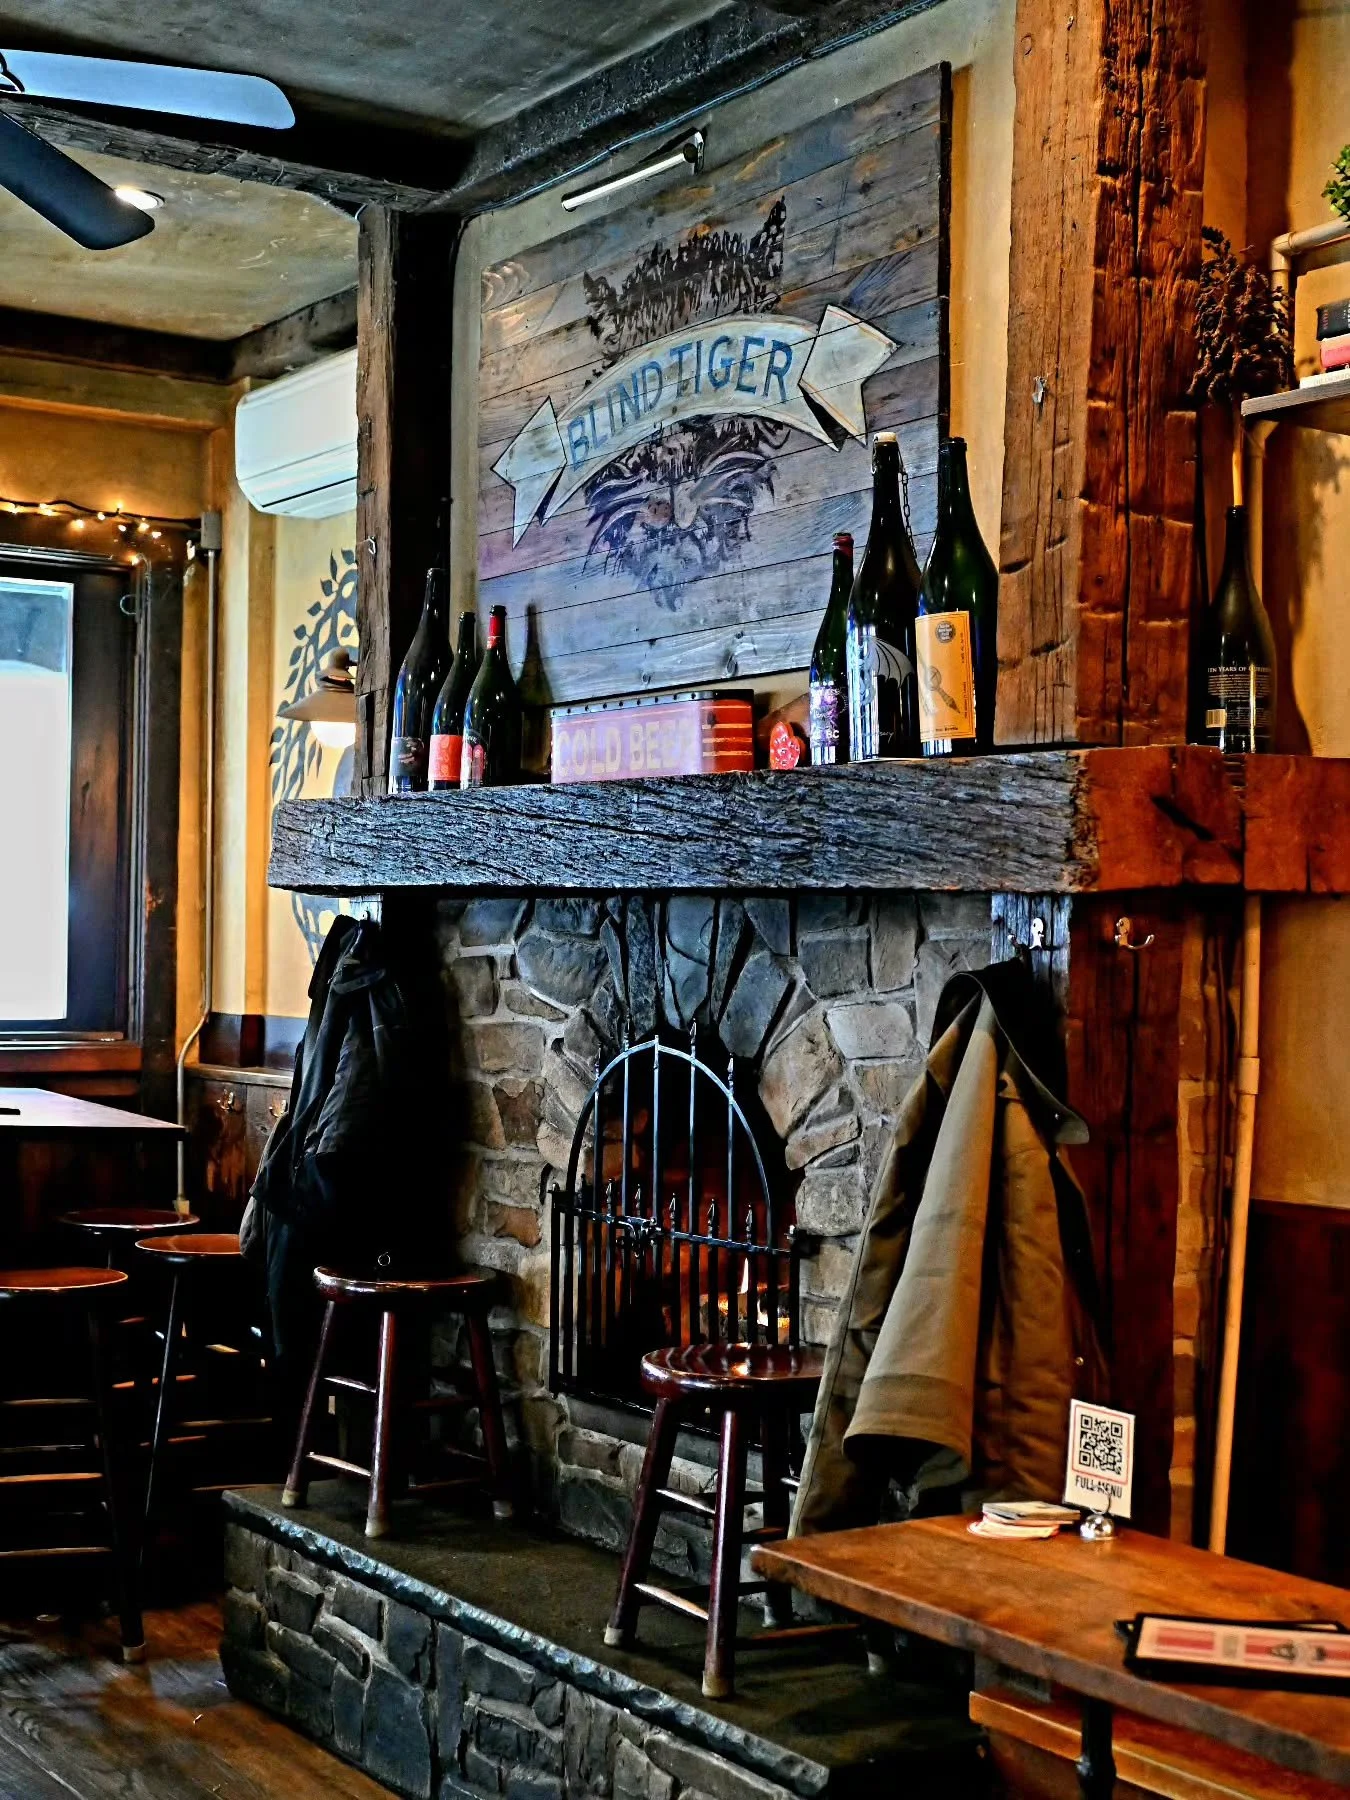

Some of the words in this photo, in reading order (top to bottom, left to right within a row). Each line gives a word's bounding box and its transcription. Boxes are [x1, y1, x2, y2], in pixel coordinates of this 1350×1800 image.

[566, 360, 664, 471] BLIND
[669, 335, 794, 403] TIGER
[557, 727, 621, 778] COLD
[629, 718, 694, 772] BEER
[1075, 1475, 1095, 1491] FULL
[1097, 1481, 1123, 1498] MENU
